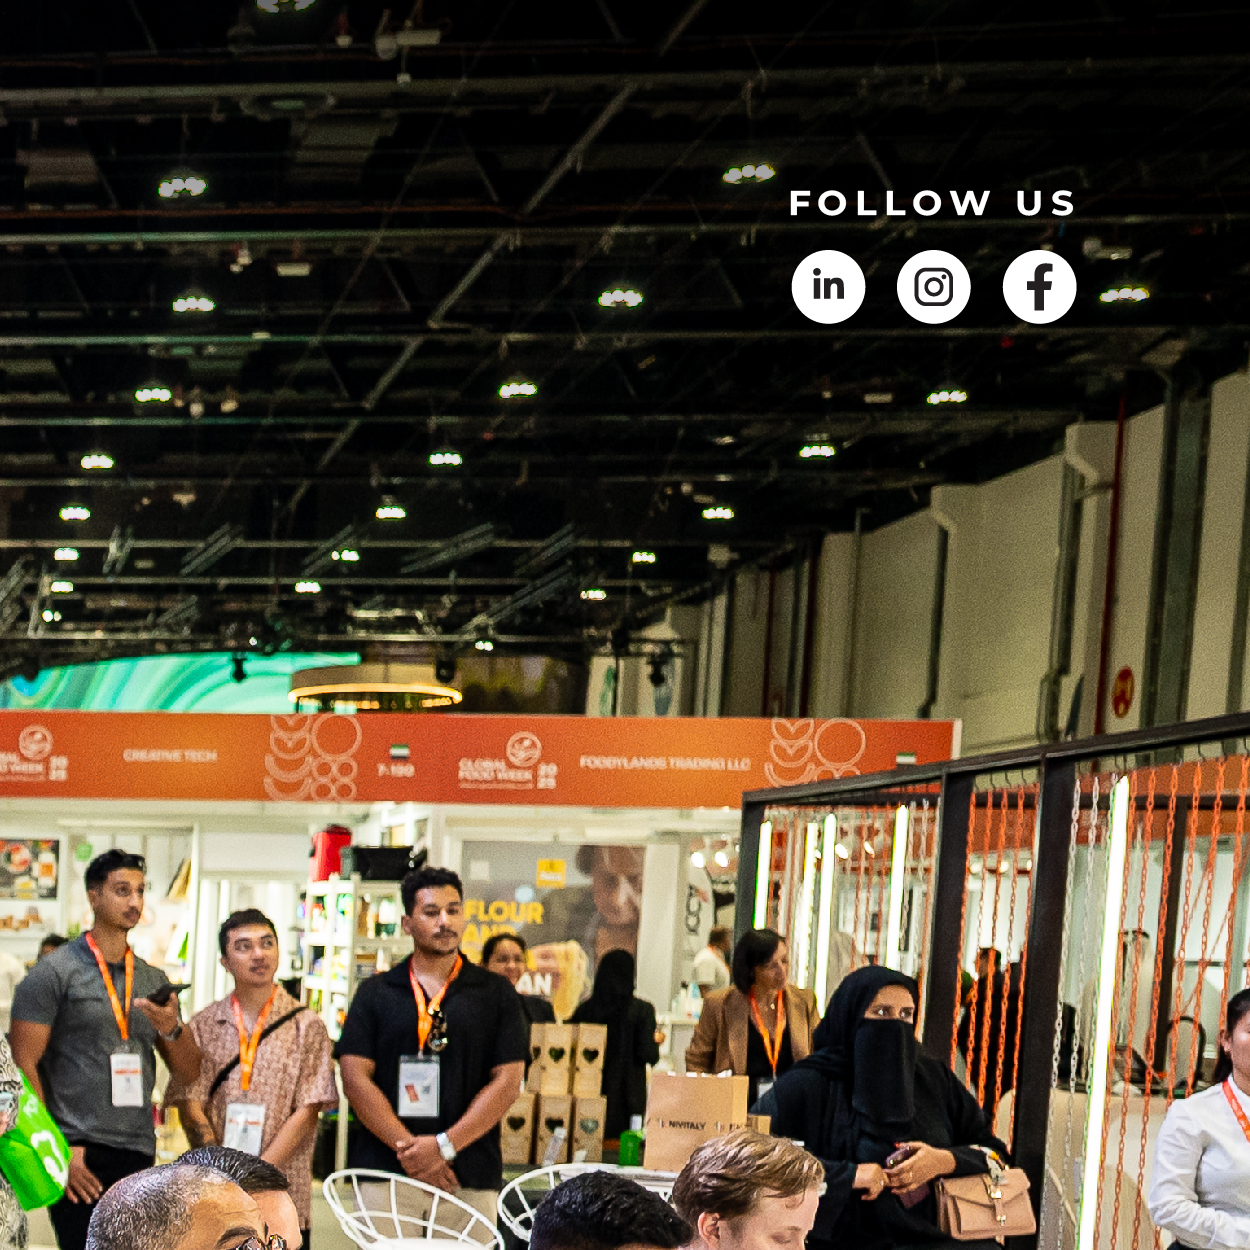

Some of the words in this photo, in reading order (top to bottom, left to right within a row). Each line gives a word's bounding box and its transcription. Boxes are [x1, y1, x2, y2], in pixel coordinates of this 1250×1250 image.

[123, 748, 182, 762] CREATIVE
[184, 749, 218, 762] TECH
[669, 757, 726, 770] TRADING
[728, 758, 751, 771] LLC
[464, 900, 544, 925] FLOUR
[515, 971, 553, 996] AN
